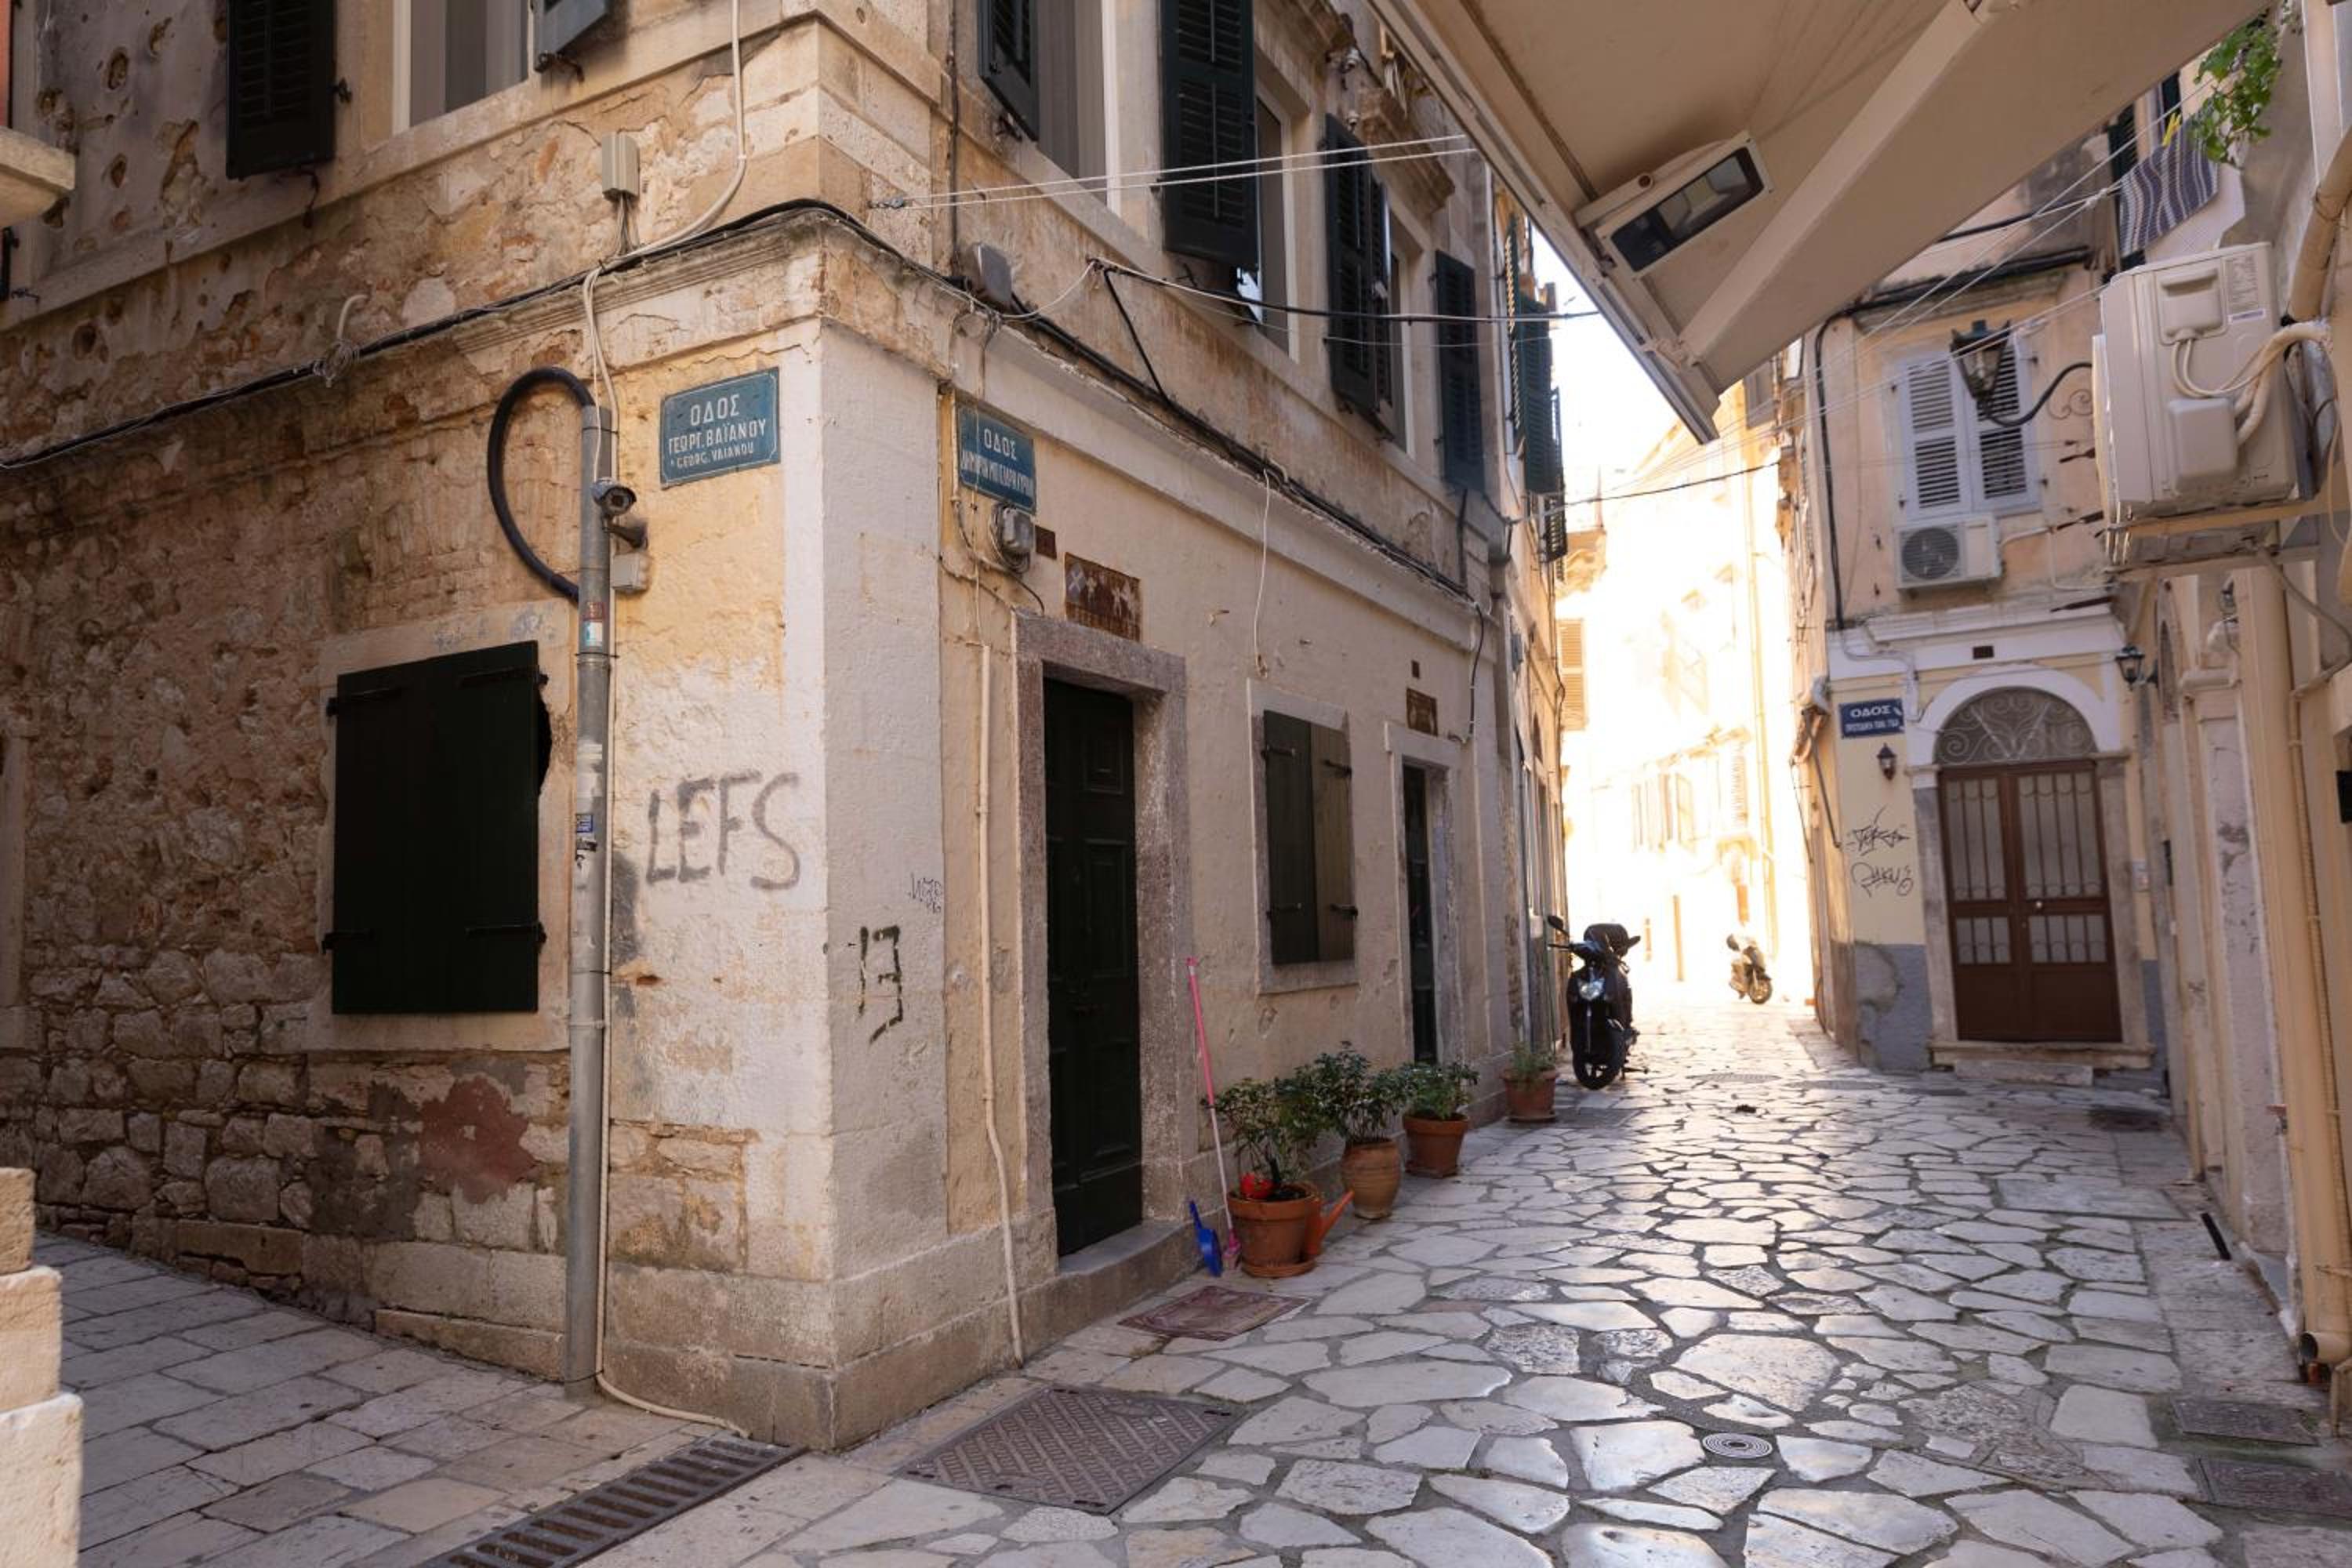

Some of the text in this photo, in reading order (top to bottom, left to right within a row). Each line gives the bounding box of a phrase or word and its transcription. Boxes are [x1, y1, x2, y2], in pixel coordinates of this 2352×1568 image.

[690, 394, 740, 426] ΟΔΟΣ
[984, 428, 1017, 461] ΟΔΟΣ
[1850, 705, 1892, 718] ΟΔΟΣ
[645, 769, 800, 891] LEFS
